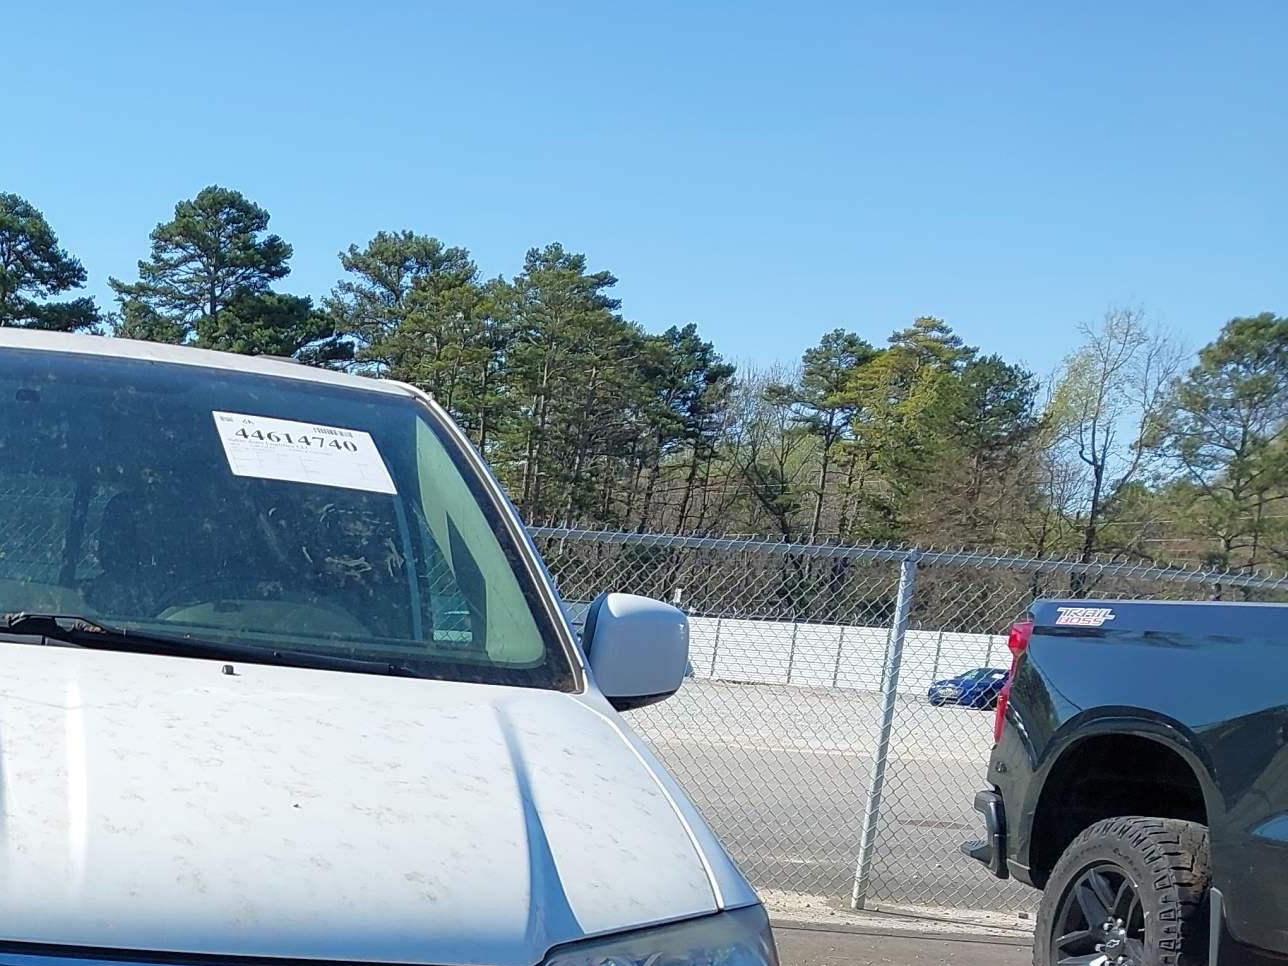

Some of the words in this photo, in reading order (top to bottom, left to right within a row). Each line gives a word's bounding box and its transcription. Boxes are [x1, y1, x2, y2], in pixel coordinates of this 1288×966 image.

[235, 427, 358, 452] 44614740
[1057, 607, 1115, 619] TRAIL
[1057, 616, 1103, 625] BOSS
